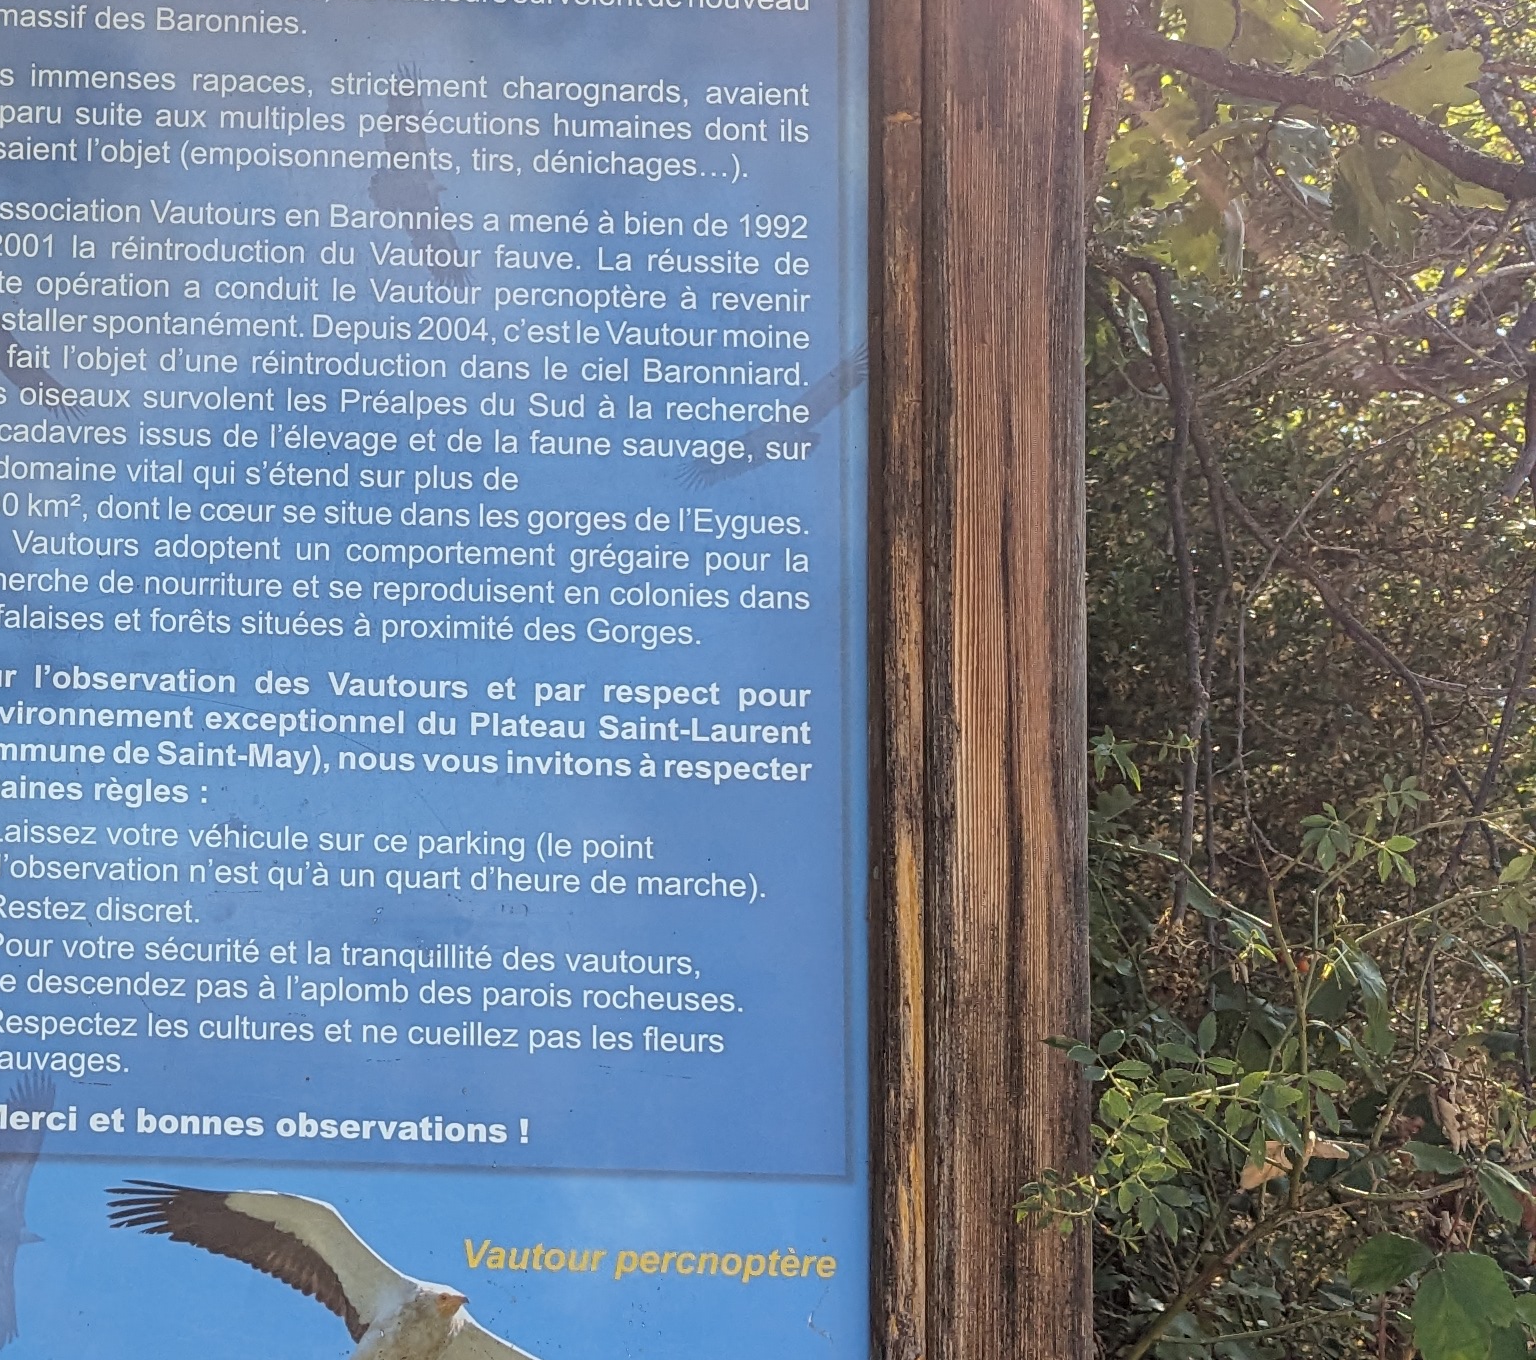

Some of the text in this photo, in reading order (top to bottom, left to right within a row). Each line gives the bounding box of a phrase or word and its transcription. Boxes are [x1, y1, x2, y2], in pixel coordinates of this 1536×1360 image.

[94, 5, 146, 31] des
[156, 6, 307, 35] Baronnies.
[94, 777, 189, 808] règles
[96, 896, 200, 923] discret.
[89, 1107, 125, 1133] et
[136, 1107, 265, 1137] bonnes
[275, 1111, 508, 1144] observations
[463, 1238, 838, 1285] Vautour percnoptère
